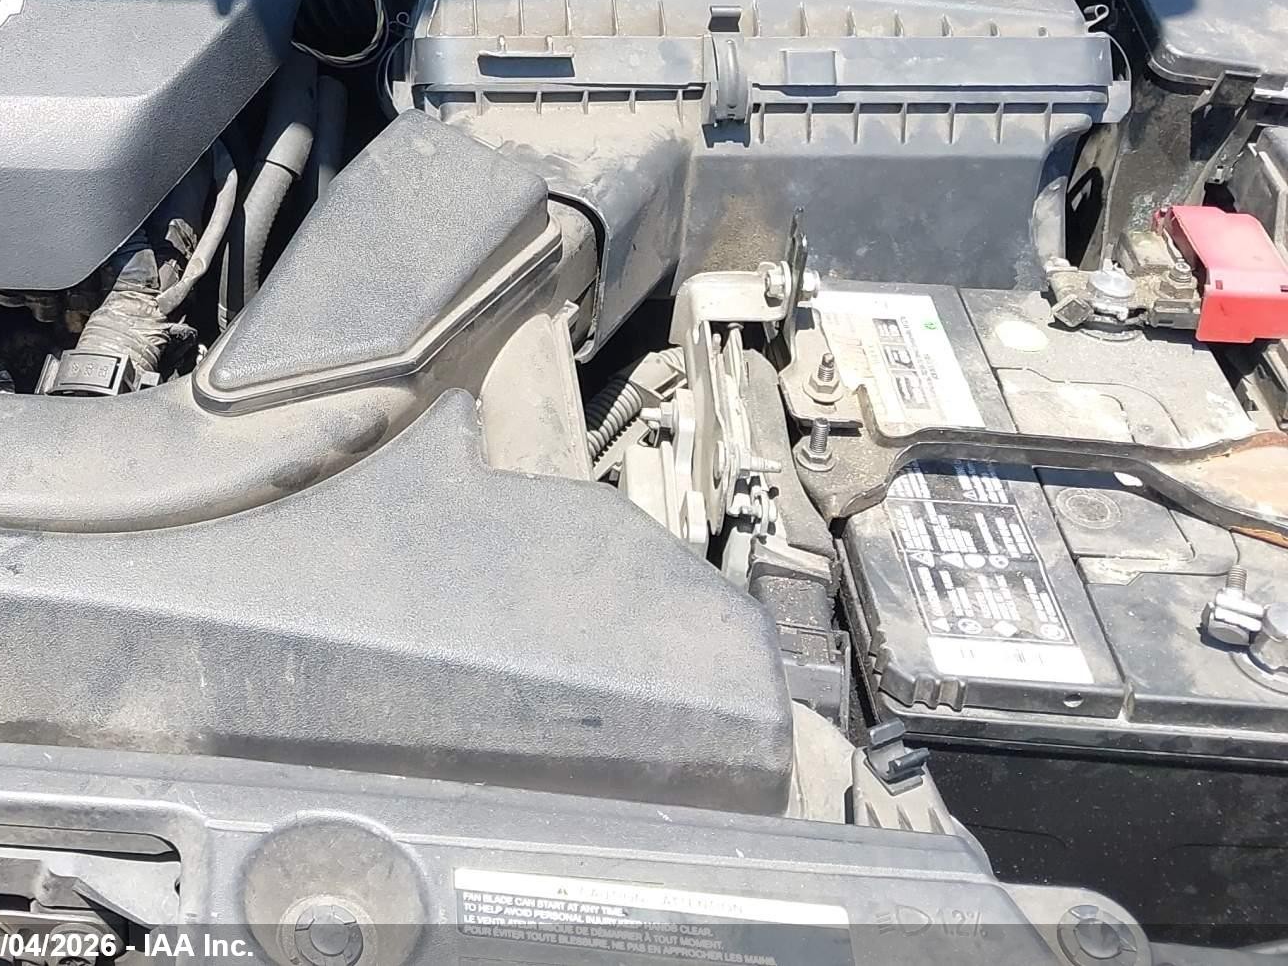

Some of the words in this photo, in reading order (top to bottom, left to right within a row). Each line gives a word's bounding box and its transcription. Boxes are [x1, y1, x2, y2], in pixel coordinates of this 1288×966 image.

[463, 892, 481, 902] FAN
[483, 894, 513, 905] BLADE
[514, 897, 535, 907] CAN
[536, 899, 565, 910] START
[567, 903, 578, 912] AT
[580, 904, 600, 914] ANY
[601, 906, 625, 917] TIME.
[464, 902, 476, 911] TO
[478, 904, 503, 914] HELP
[504, 907, 532, 917] AVOID
[533, 909, 584, 923] PERSONAL
[644, 922, 678, 932] HANDS
[680, 925, 713, 937] CLEAR.
[463, 914, 476, 924] LE
[576, 926, 590, 936] DE
[591, 926, 643, 941] DÉMARRER
[644, 931, 652, 943] À
[653, 934, 678, 945] TOUT
[679, 937, 724, 950] MOMENT.
[464, 924, 491, 936] POUR
[493, 926, 524, 940] ÉVITER
[526, 930, 557, 943] TOUTE
[611, 940, 626, 950] NE
[627, 942, 646, 953] PAS
[648, 945, 661, 954] EN
[663, 946, 723, 961] APPROCHER
[724, 952, 742, 963] LES
